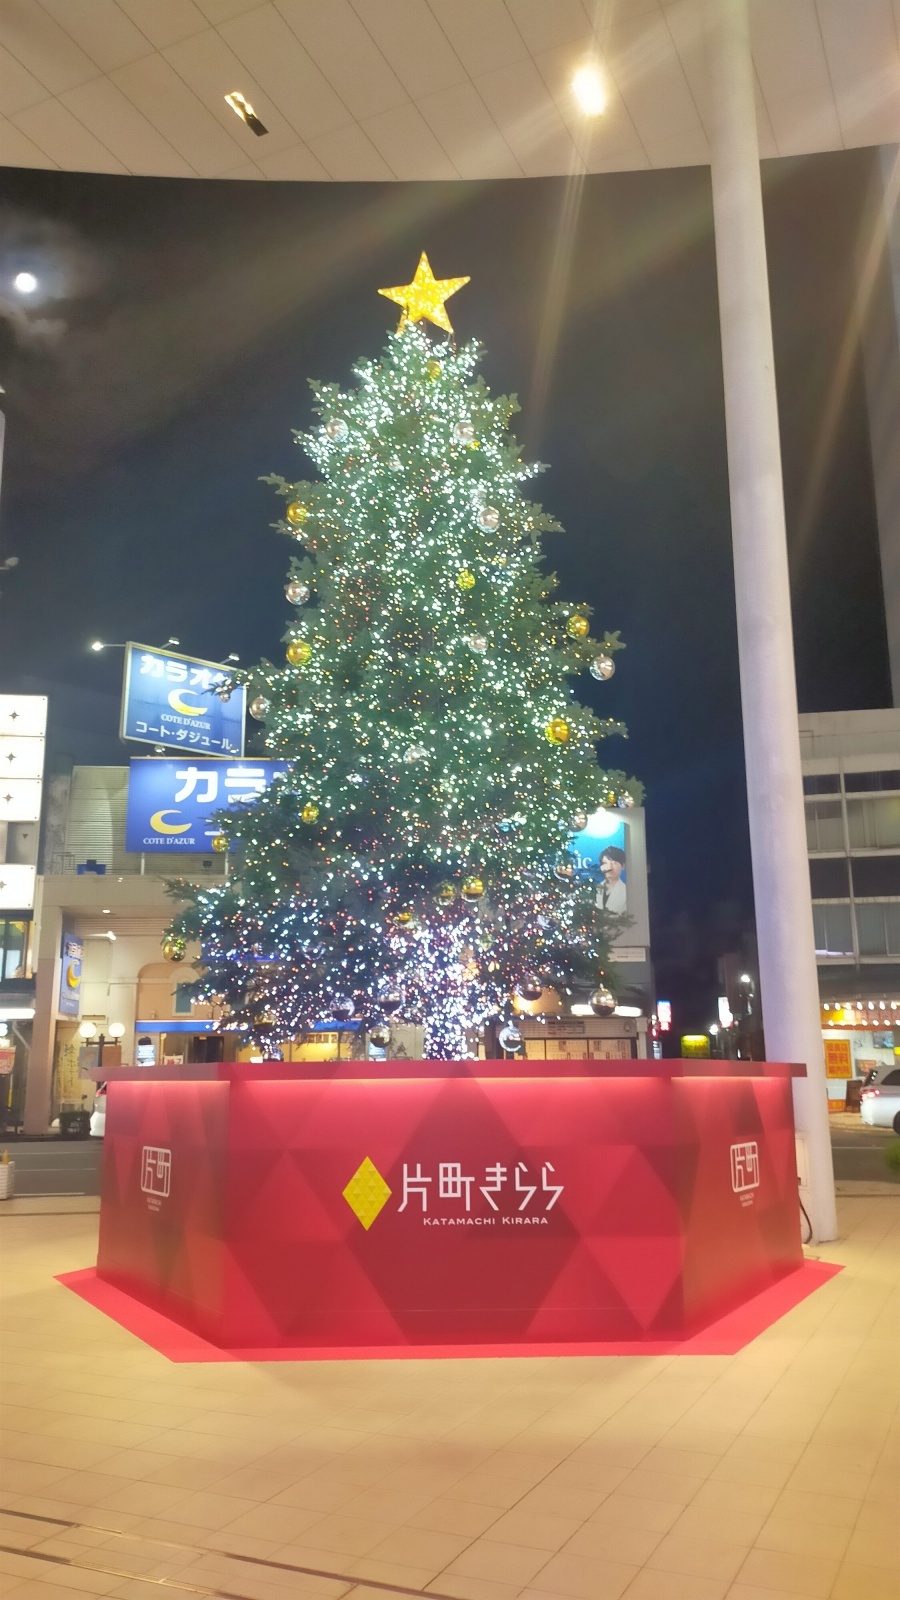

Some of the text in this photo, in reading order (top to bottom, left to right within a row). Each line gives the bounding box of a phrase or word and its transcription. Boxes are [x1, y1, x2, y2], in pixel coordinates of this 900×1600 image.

[183, 717, 211, 730] D'AZUR
[136, 721, 233, 750] コート・ダジュール
[143, 836, 195, 845] COTE D'AZUR
[397, 1162, 564, 1212] 片町きらら
[423, 1216, 549, 1226] KATAMACHI KIRARA
